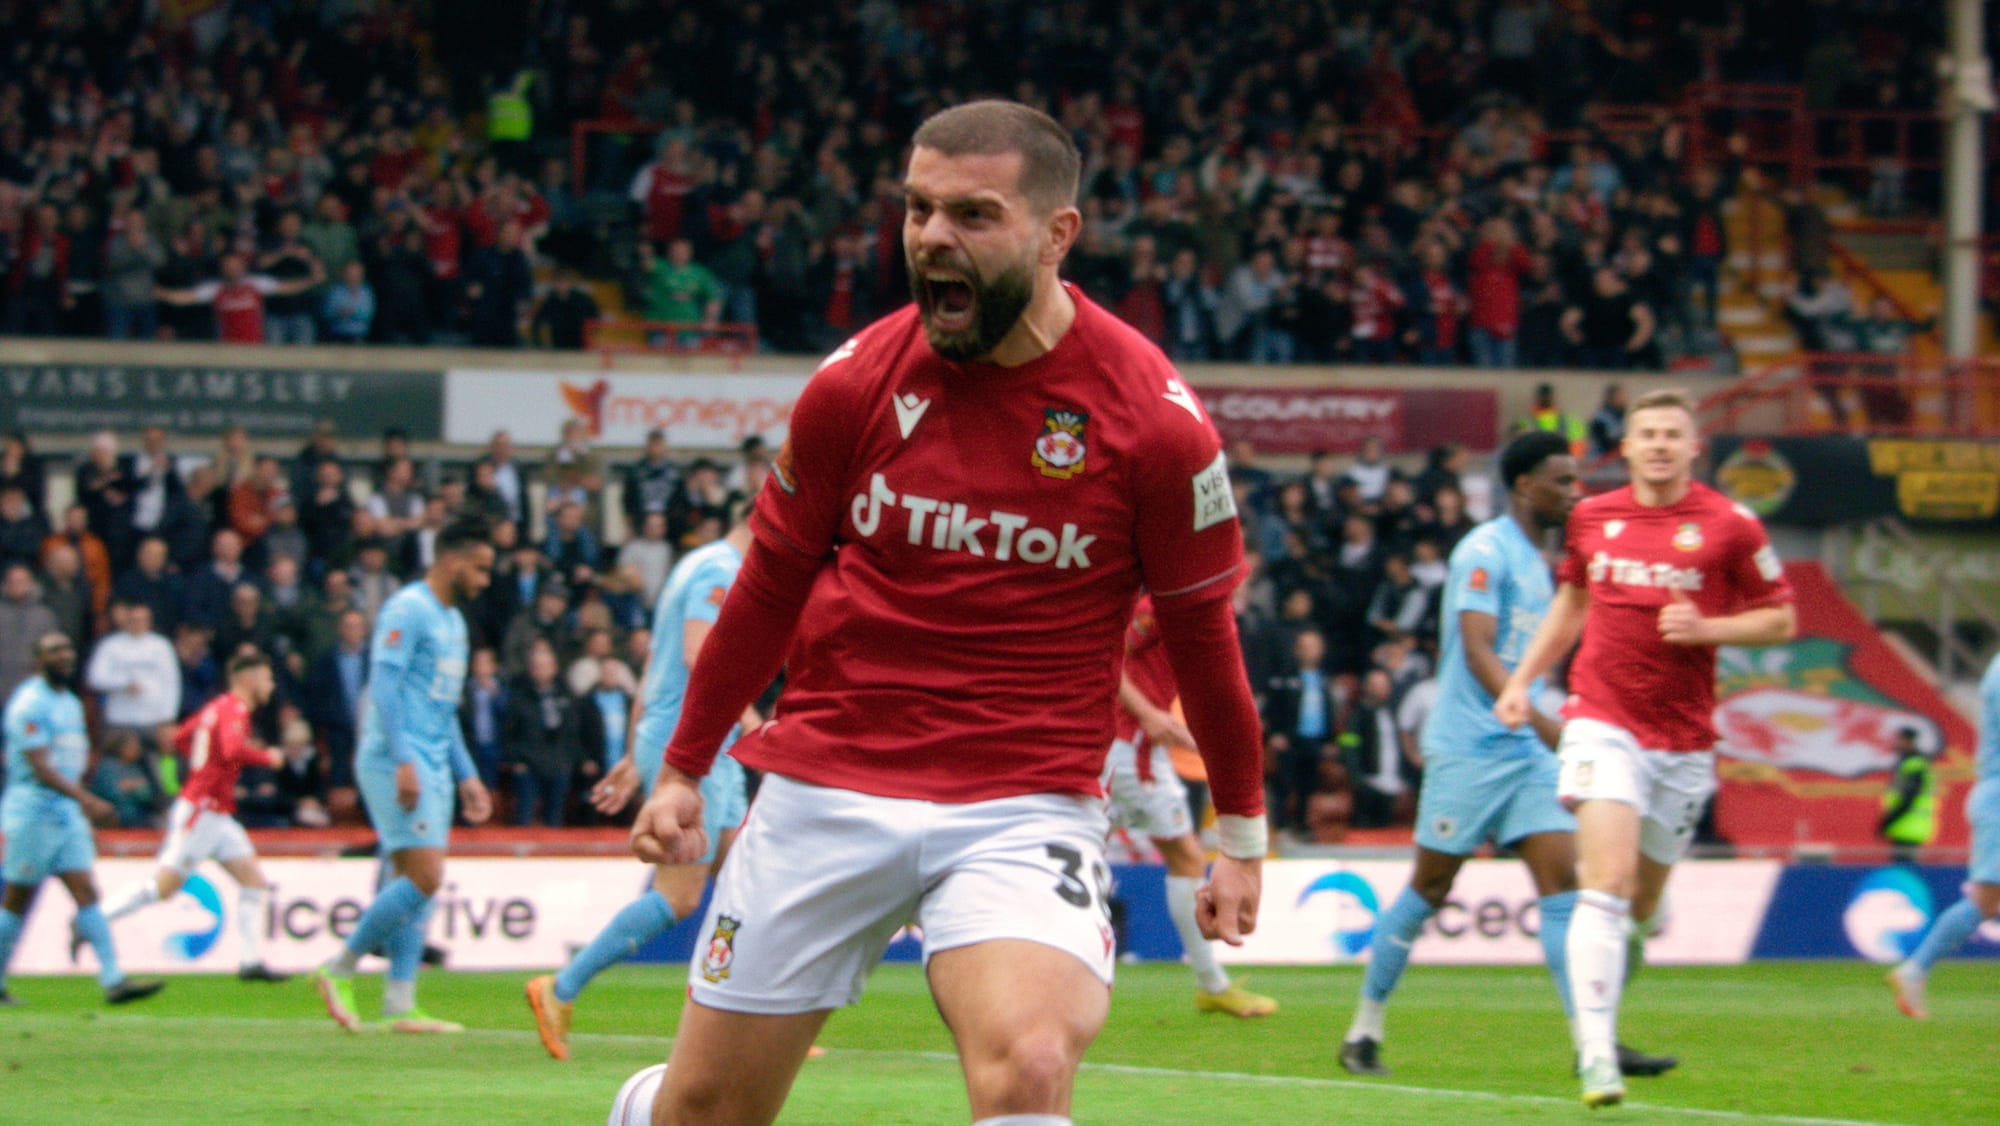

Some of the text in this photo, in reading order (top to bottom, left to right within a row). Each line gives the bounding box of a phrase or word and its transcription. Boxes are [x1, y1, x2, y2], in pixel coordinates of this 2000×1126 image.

[7, 369, 354, 403] VANS LAMSLEY
[901, 494, 1098, 570] TikTok
[265, 884, 537, 940] iceive
